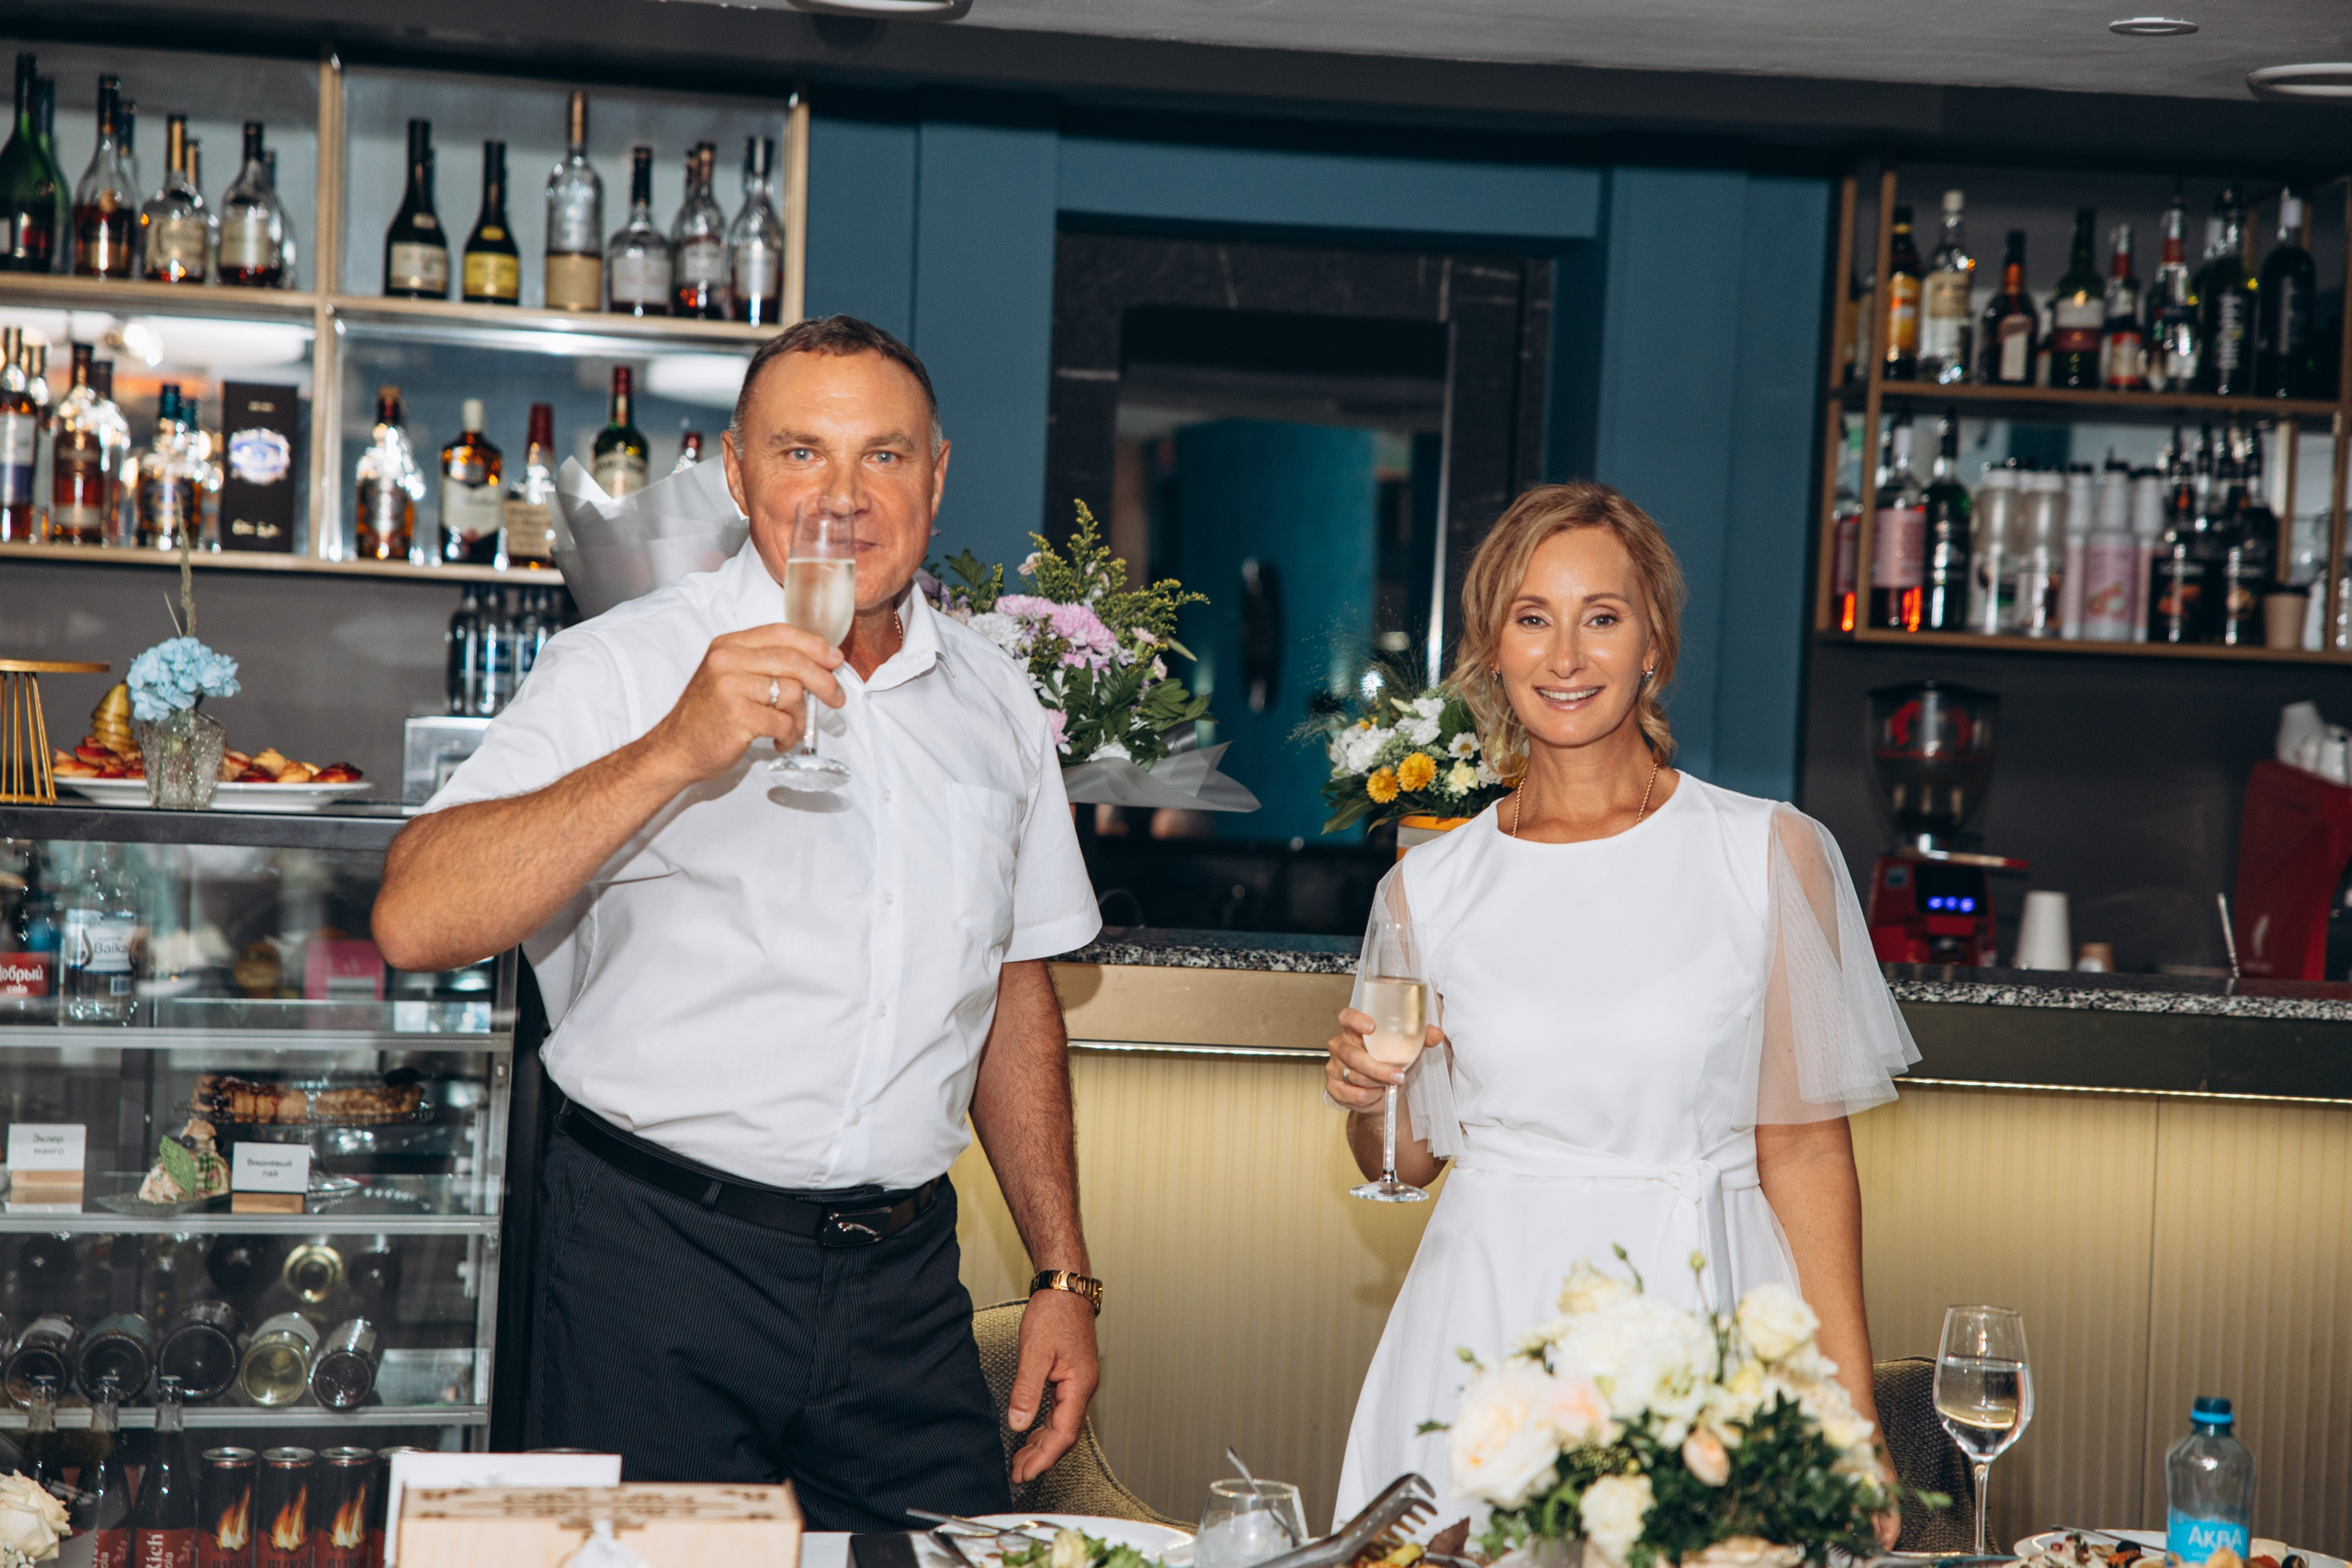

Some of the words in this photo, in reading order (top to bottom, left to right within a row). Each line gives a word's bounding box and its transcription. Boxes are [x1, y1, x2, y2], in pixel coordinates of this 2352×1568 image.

[6, 983, 28, 994] cola
[98, 1551, 109, 1568] ola
[163, 1551, 174, 1568] ola
